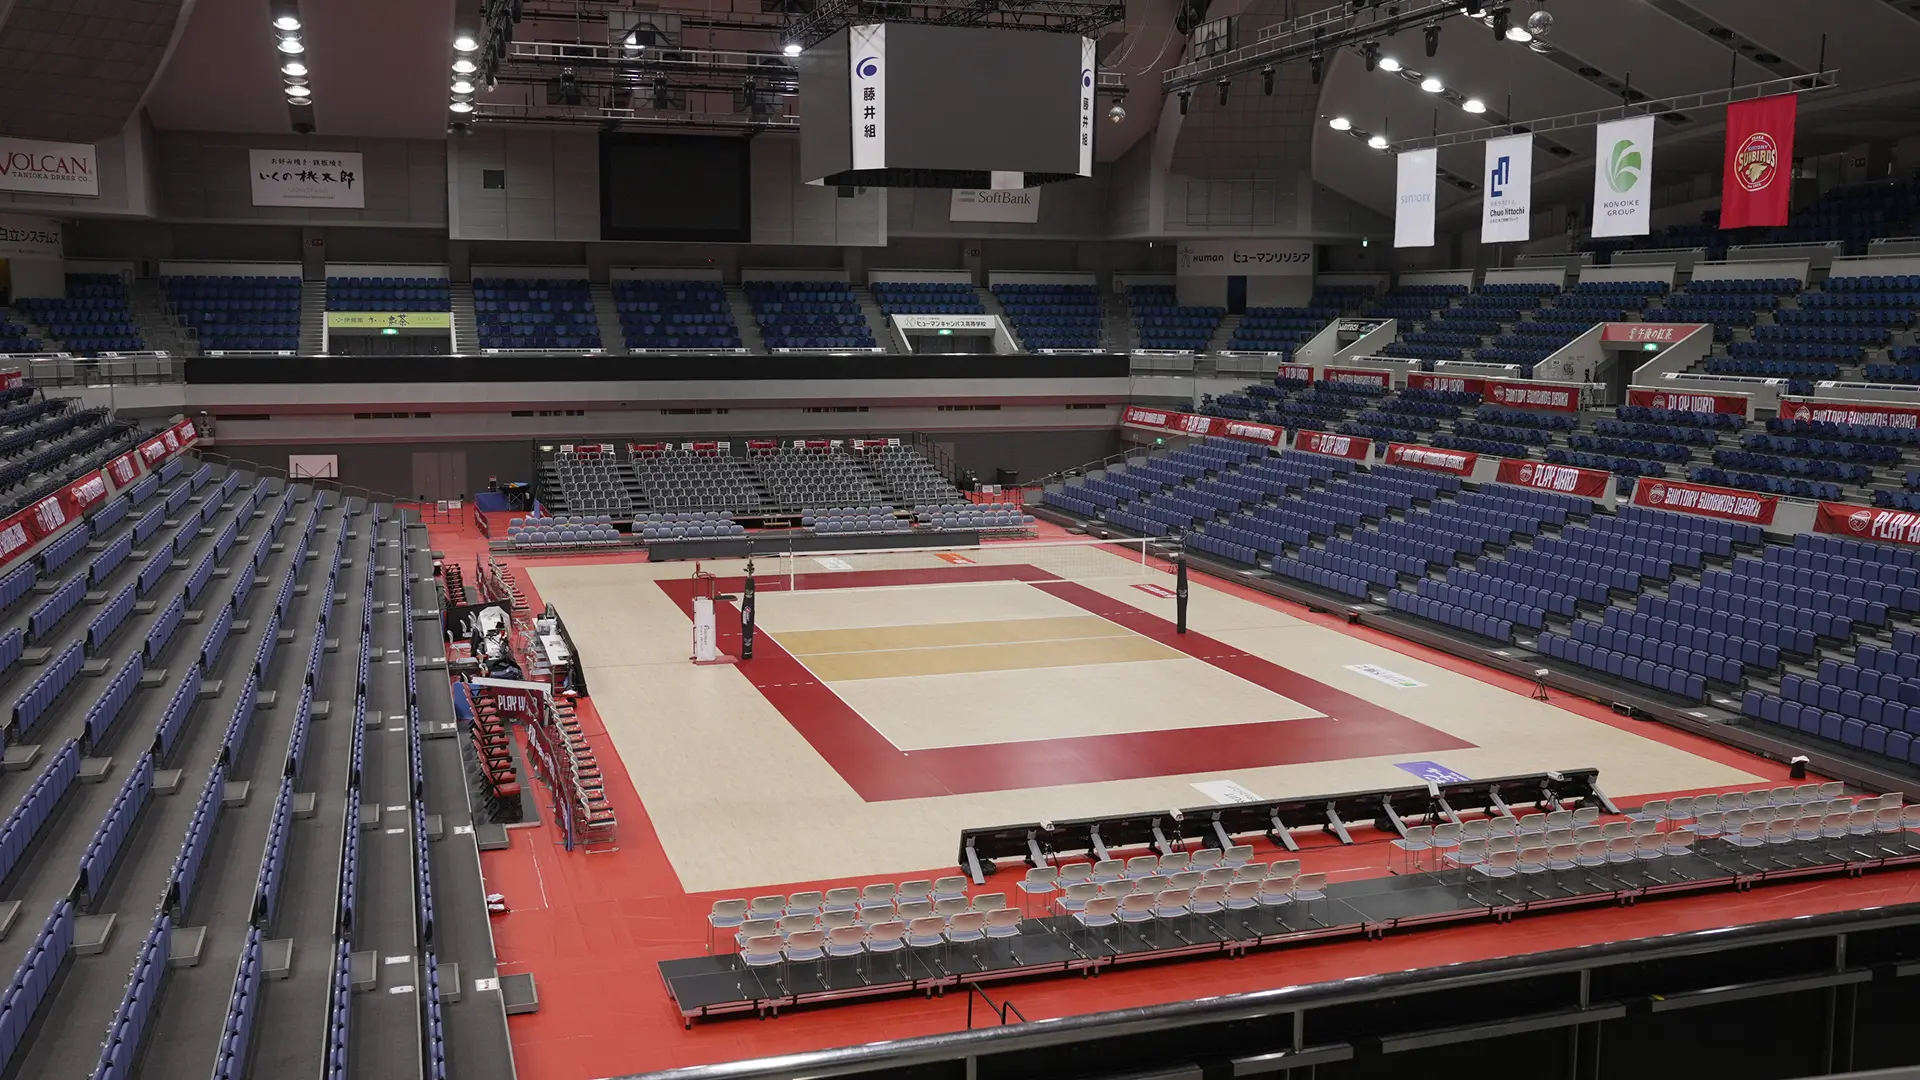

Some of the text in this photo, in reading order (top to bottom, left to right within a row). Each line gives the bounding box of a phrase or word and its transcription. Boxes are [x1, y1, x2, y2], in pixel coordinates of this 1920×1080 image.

[864, 87, 876, 138] 藤井組
[0, 152, 88, 176] VOLCAN
[1738, 149, 1776, 172] SUNBIRDS
[12, 171, 48, 180] TANIOKA
[260, 169, 355, 190] いくの桃太郎
[978, 191, 1031, 204] SoftBank
[1603, 200, 1640, 208] KONOIKE
[1489, 209, 1505, 217] Chuo
[1607, 208, 1635, 216] GROUP
[1233, 251, 1311, 263] ヒューマンリソシア
[1531, 464, 1580, 491] PLAY HARD
[1664, 487, 1761, 518] SUNTORY SUNBIRDS OSAKA
[1871, 511, 1916, 541] PLAY
[497, 694, 518, 712] PLAY
